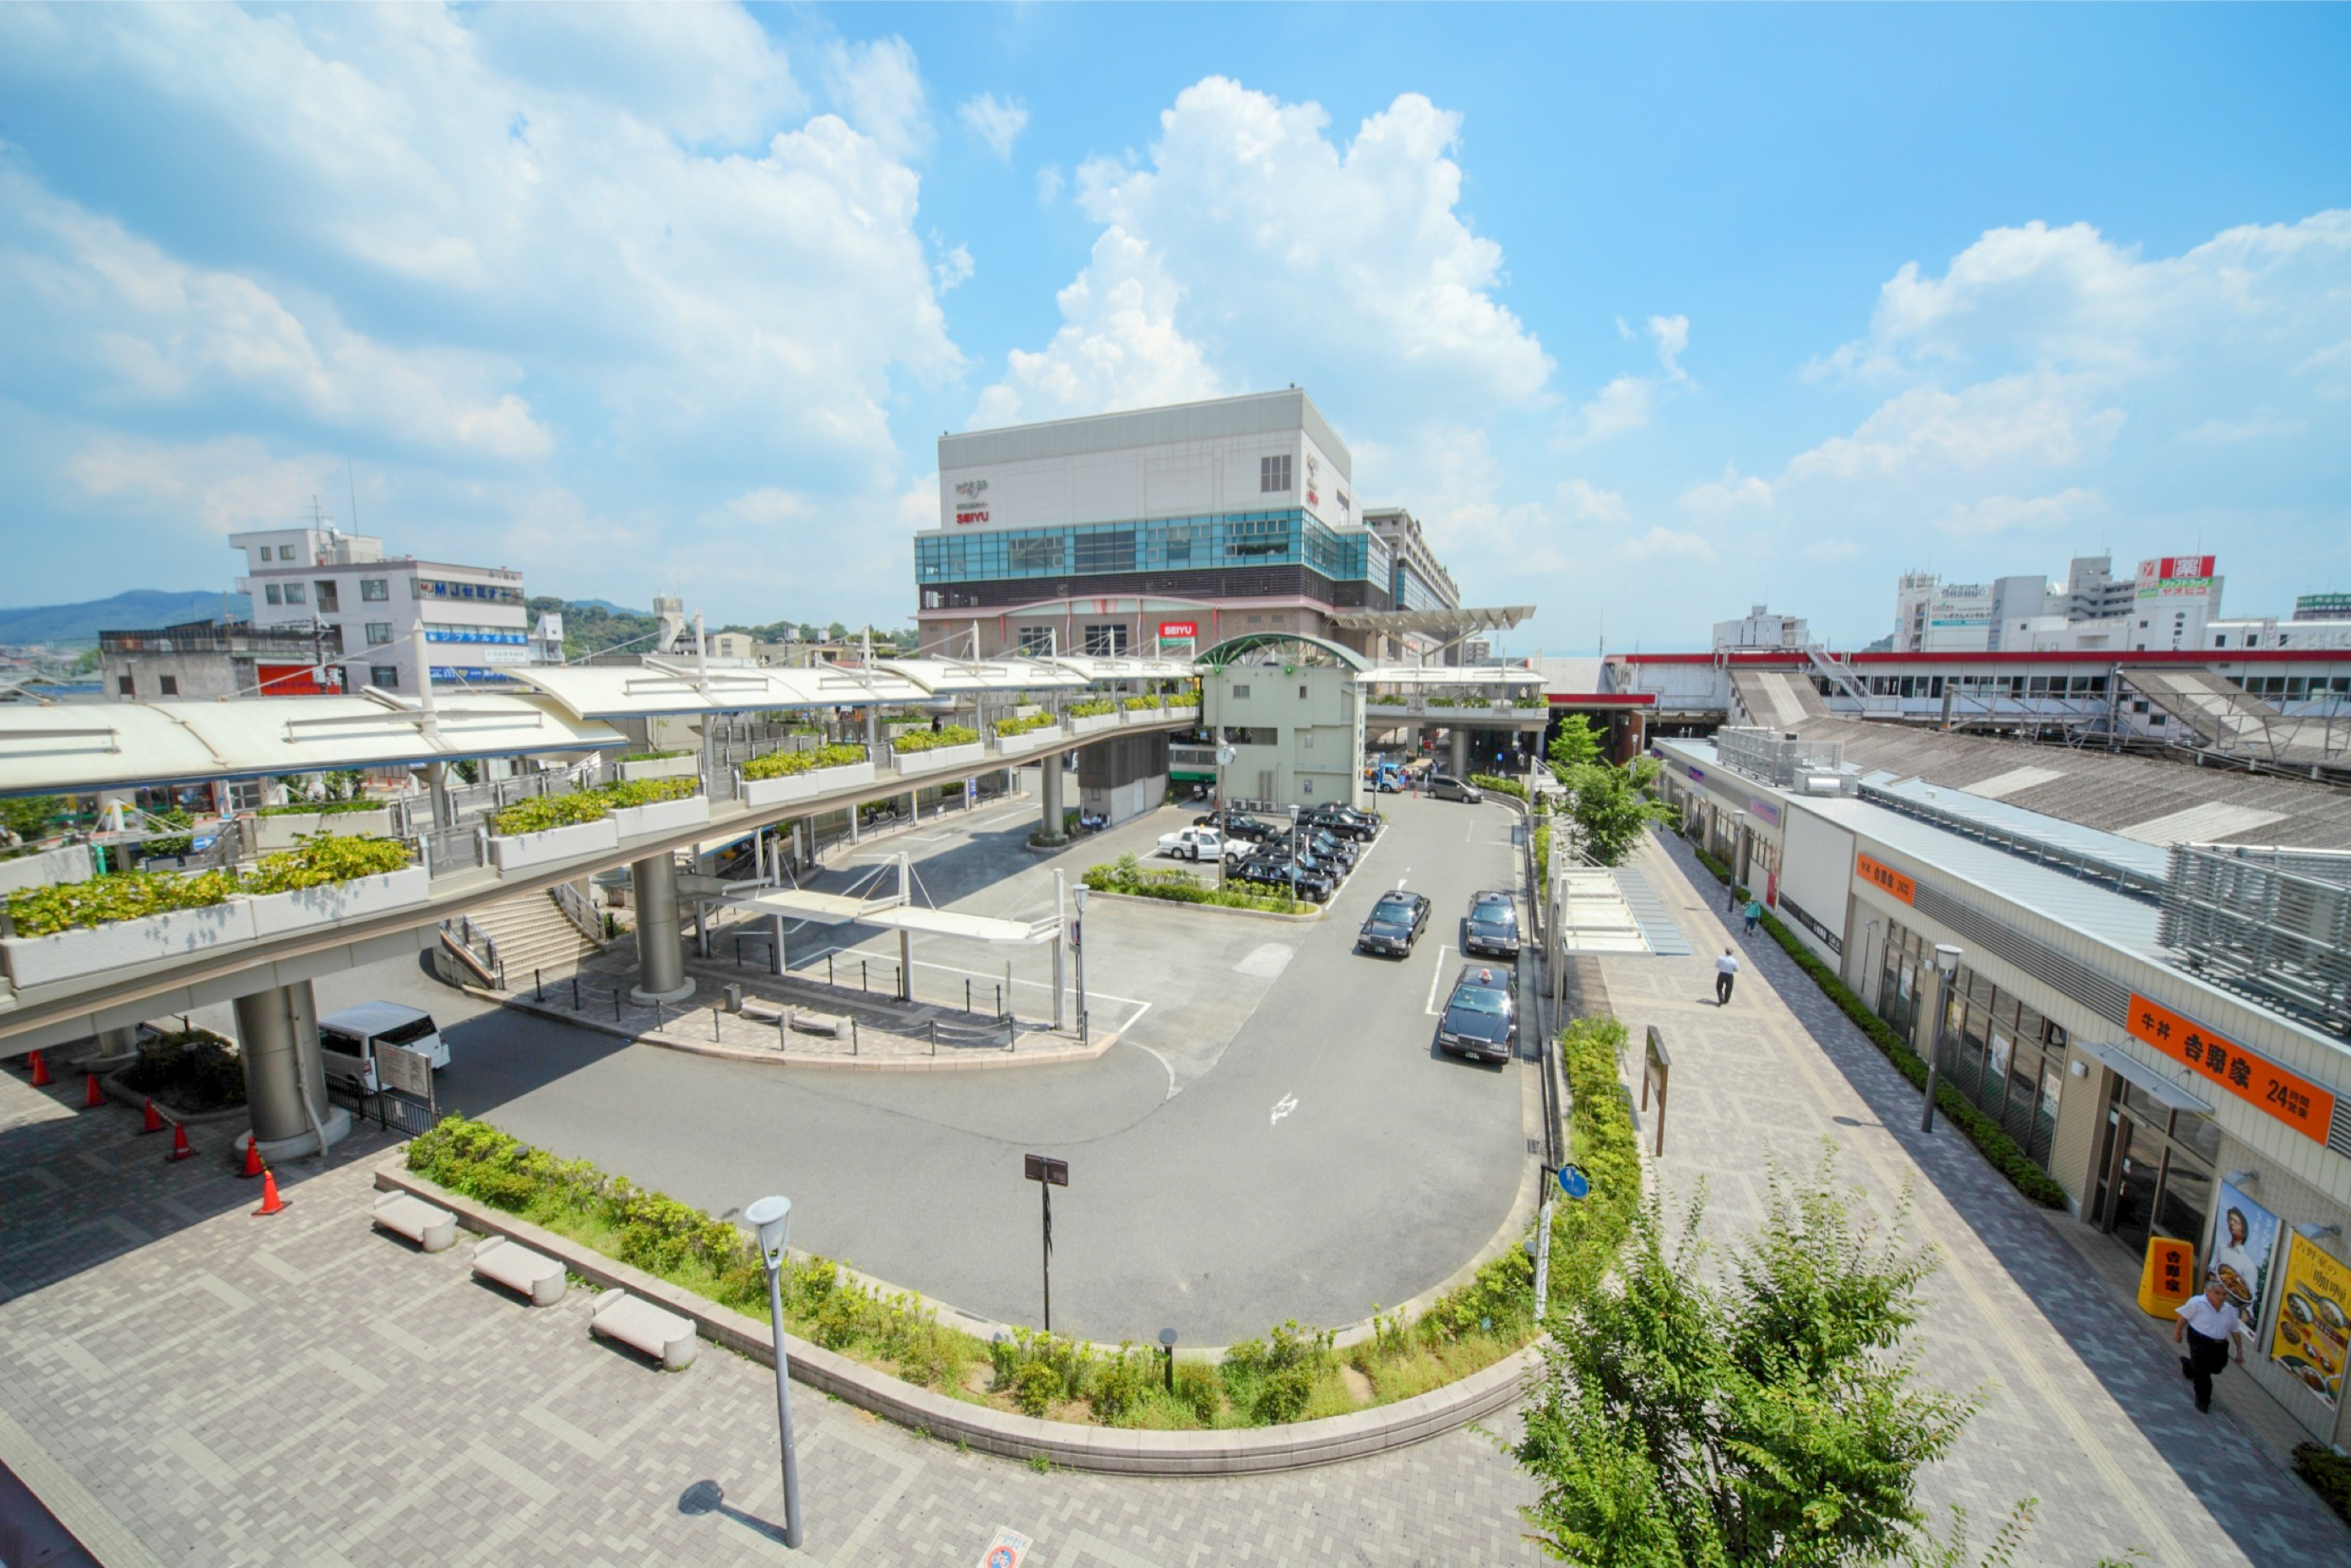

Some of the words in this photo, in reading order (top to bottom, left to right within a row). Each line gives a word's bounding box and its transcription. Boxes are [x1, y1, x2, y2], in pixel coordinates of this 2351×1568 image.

[957, 512, 989, 524] SEIYU
[2176, 558, 2200, 578] 薬
[1941, 588, 1985, 598] MASAGO
[1165, 626, 1192, 635] SEIYU
[1874, 866, 1894, 889] 吉野家
[2142, 1012, 2170, 1040] 牛丼
[2184, 1034, 2251, 1089] 吉野家
[2267, 1079, 2289, 1108] 24
[2289, 1091, 2310, 1109] 時間
[2288, 1104, 2309, 1120] 営業
[2166, 1251, 2180, 1292] 吉野家
